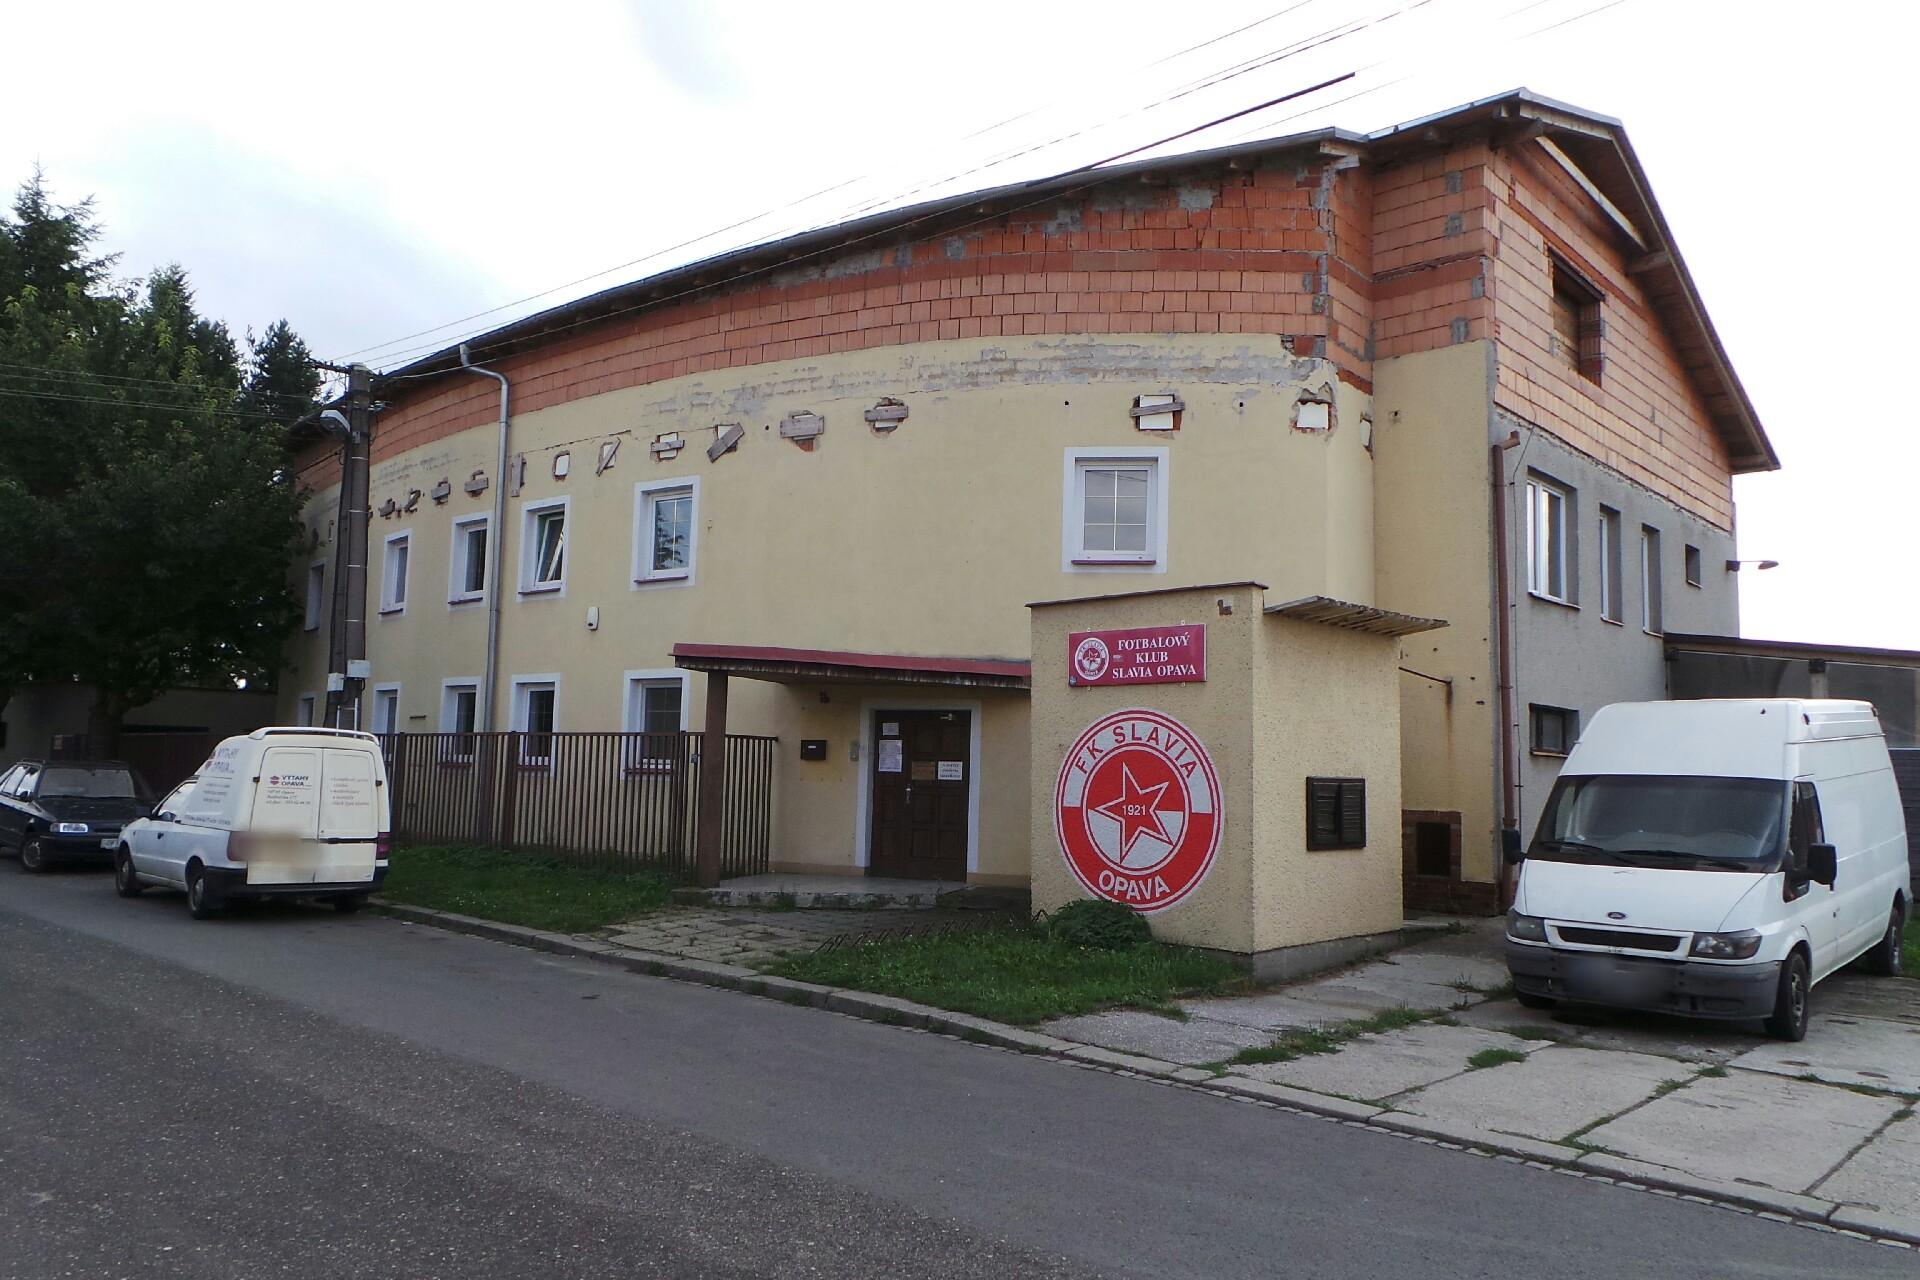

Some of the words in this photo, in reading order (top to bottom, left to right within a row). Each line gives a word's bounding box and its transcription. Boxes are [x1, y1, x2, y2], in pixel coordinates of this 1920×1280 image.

[1118, 631, 1190, 651] FOTBALOVÝ
[1136, 652, 1168, 664] KLUB
[1112, 666, 1152, 679] SLAVIA
[1157, 664, 1197, 677] OPAVA
[1075, 740, 1104, 775] FK
[1112, 723, 1200, 779] SLAVIA
[1122, 804, 1147, 816] 1921
[1098, 869, 1171, 901] OPAVA
